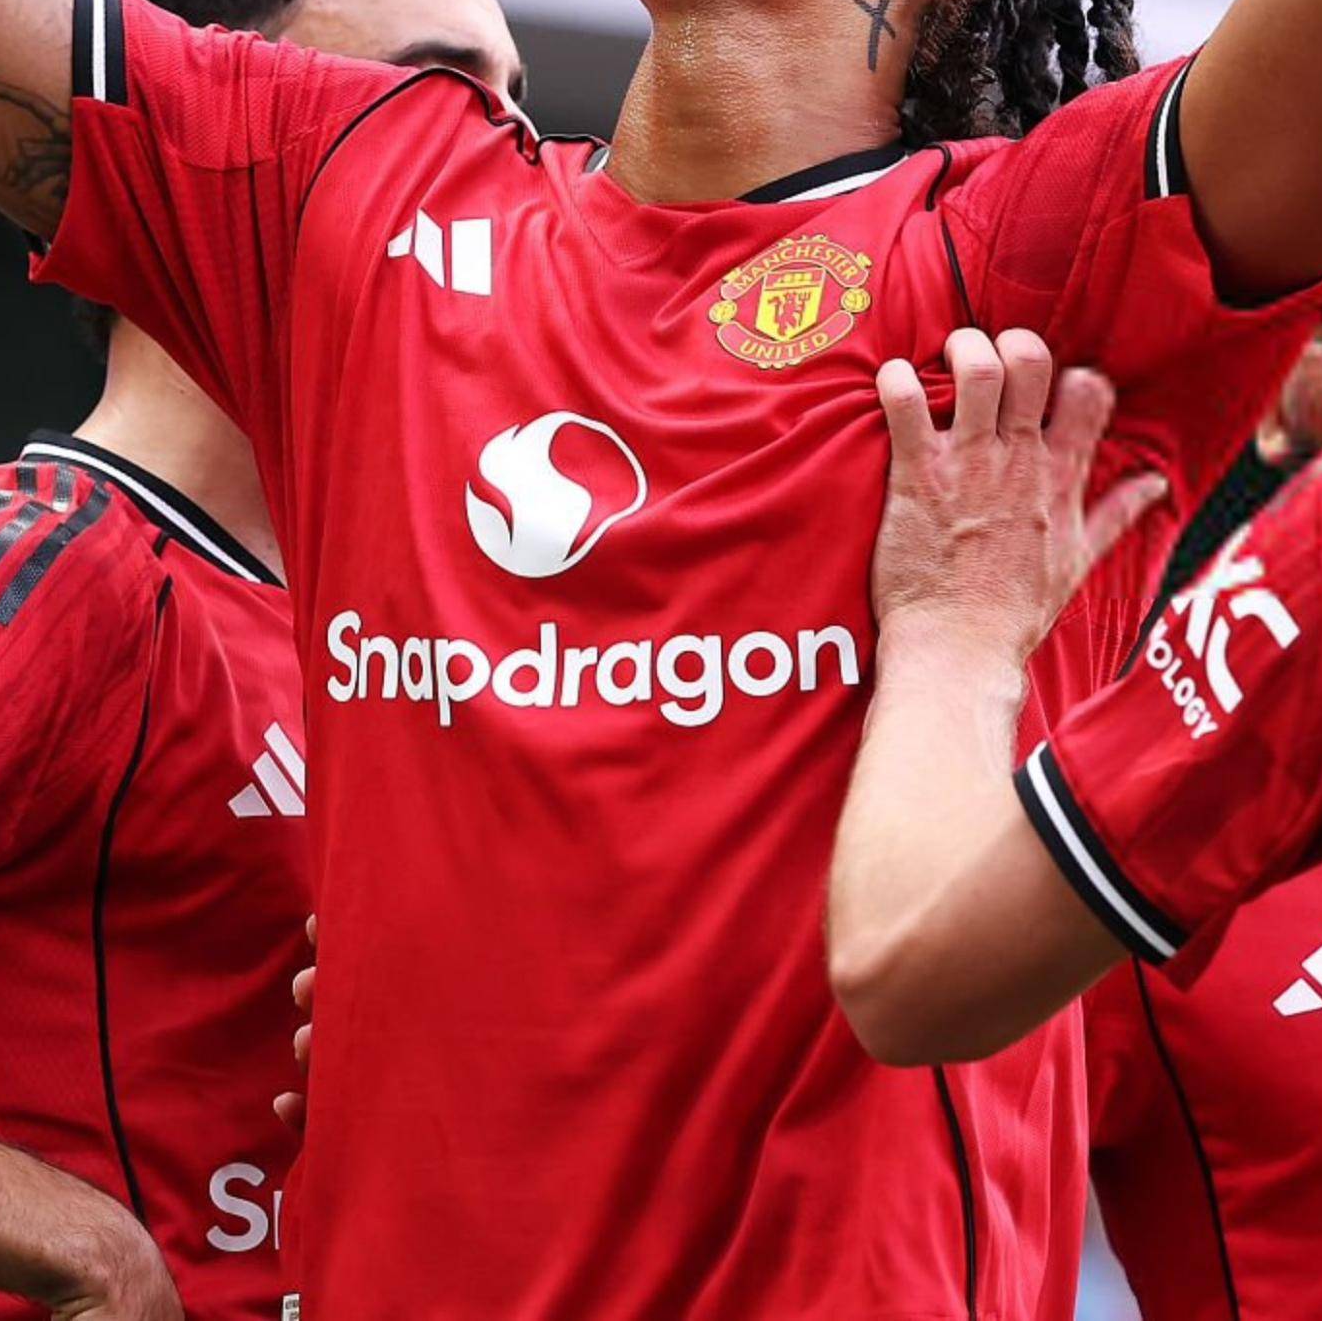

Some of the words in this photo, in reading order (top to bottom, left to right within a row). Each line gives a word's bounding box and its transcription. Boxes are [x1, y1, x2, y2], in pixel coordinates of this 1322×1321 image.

[733, 244, 860, 291] MANCHESTER
[739, 332, 829, 360] UNITED
[326, 609, 860, 727] Snapdragon
[205, 1162, 283, 1253] S
